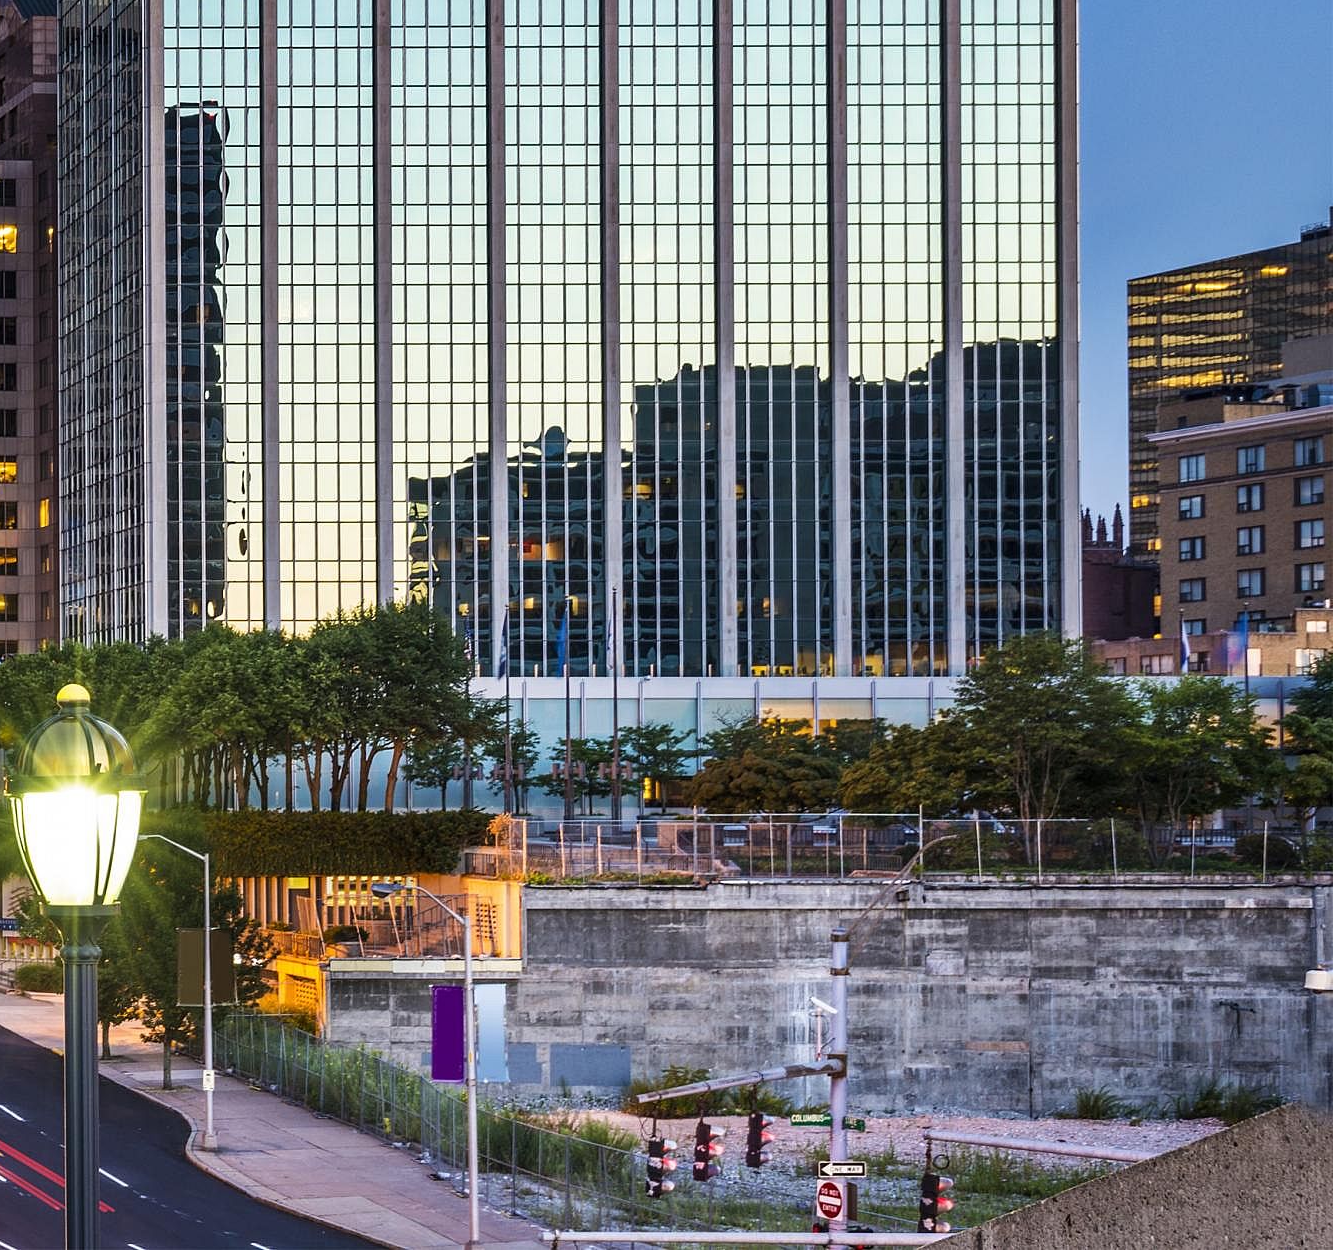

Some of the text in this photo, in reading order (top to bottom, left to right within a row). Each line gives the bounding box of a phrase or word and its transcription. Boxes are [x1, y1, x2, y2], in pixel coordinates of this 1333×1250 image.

[791, 1114, 824, 1123] COLUMBUS
[821, 1187, 839, 1197] DO NOT
[822, 1204, 838, 1213] ENTER
